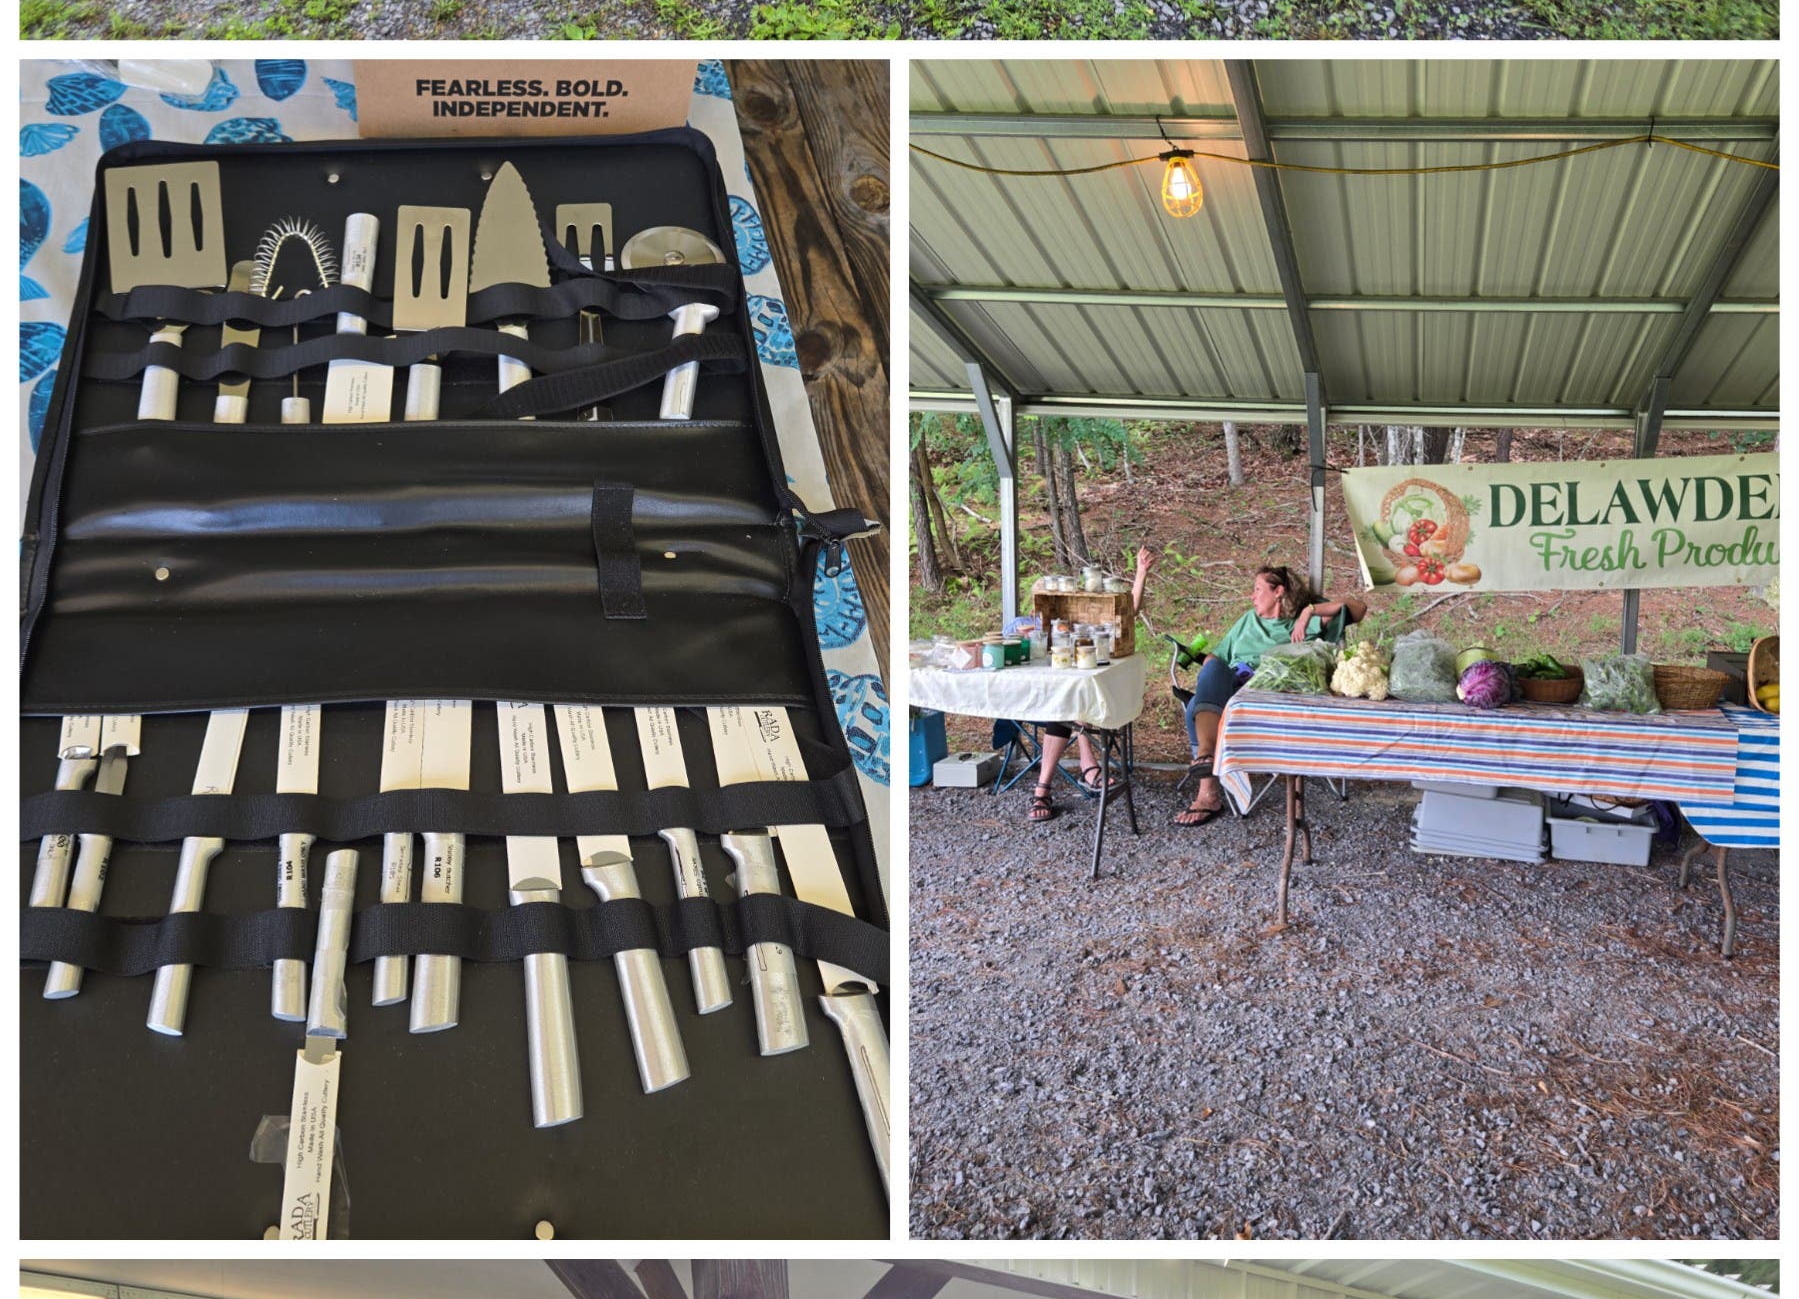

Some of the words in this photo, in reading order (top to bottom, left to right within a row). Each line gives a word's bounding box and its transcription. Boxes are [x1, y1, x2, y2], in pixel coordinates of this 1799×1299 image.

[416, 79, 549, 97] FEARLESS.
[556, 80, 628, 97] BOLD.
[433, 101, 609, 117] INDEPENDENT.
[1488, 473, 1780, 528] DELAWDE
[1529, 528, 1647, 572] Fresh
[761, 710, 781, 742] RADA
[434, 857, 442, 878] R106
[321, 1079, 330, 1104] Cutlery
[319, 1105, 328, 1129] Quality
[297, 1124, 306, 1150] Carbon
[307, 1134, 316, 1153] Made
[296, 1152, 304, 1169] High
